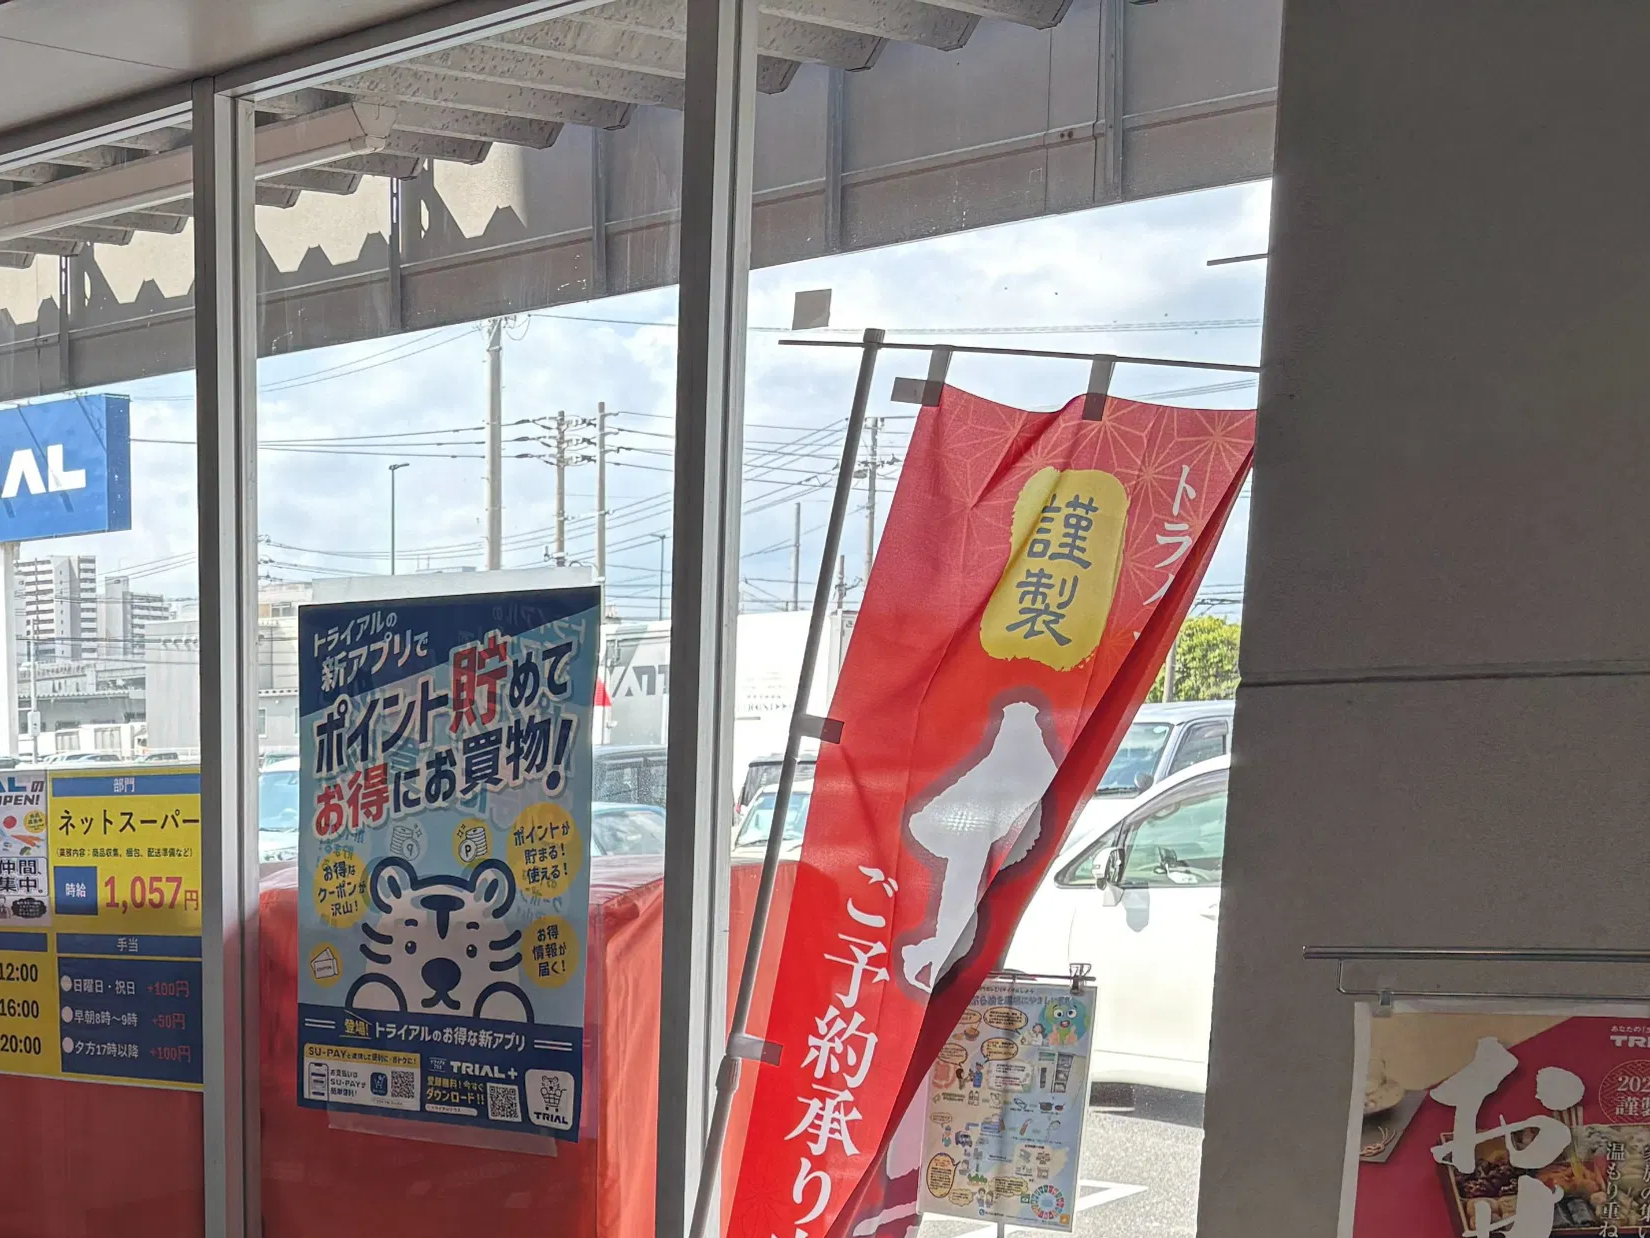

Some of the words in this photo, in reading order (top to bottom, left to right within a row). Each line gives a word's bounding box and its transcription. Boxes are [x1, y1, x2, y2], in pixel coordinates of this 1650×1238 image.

[1005, 494, 1098, 647] 謹製
[313, 611, 398, 657] トライアルの
[321, 630, 429, 691] 新アプリで
[315, 630, 574, 774] ポイント貯めて
[113, 777, 135, 793] 部門
[58, 809, 200, 836] ネットスーパー
[513, 822, 570, 847] ポイントが
[65, 882, 87, 898] 時給
[117, 937, 138, 952] 手当
[537, 924, 559, 942] お得
[376, 1021, 526, 1052] トライアルのお得な新アプリ
[533, 1111, 569, 1125] TRIAL
